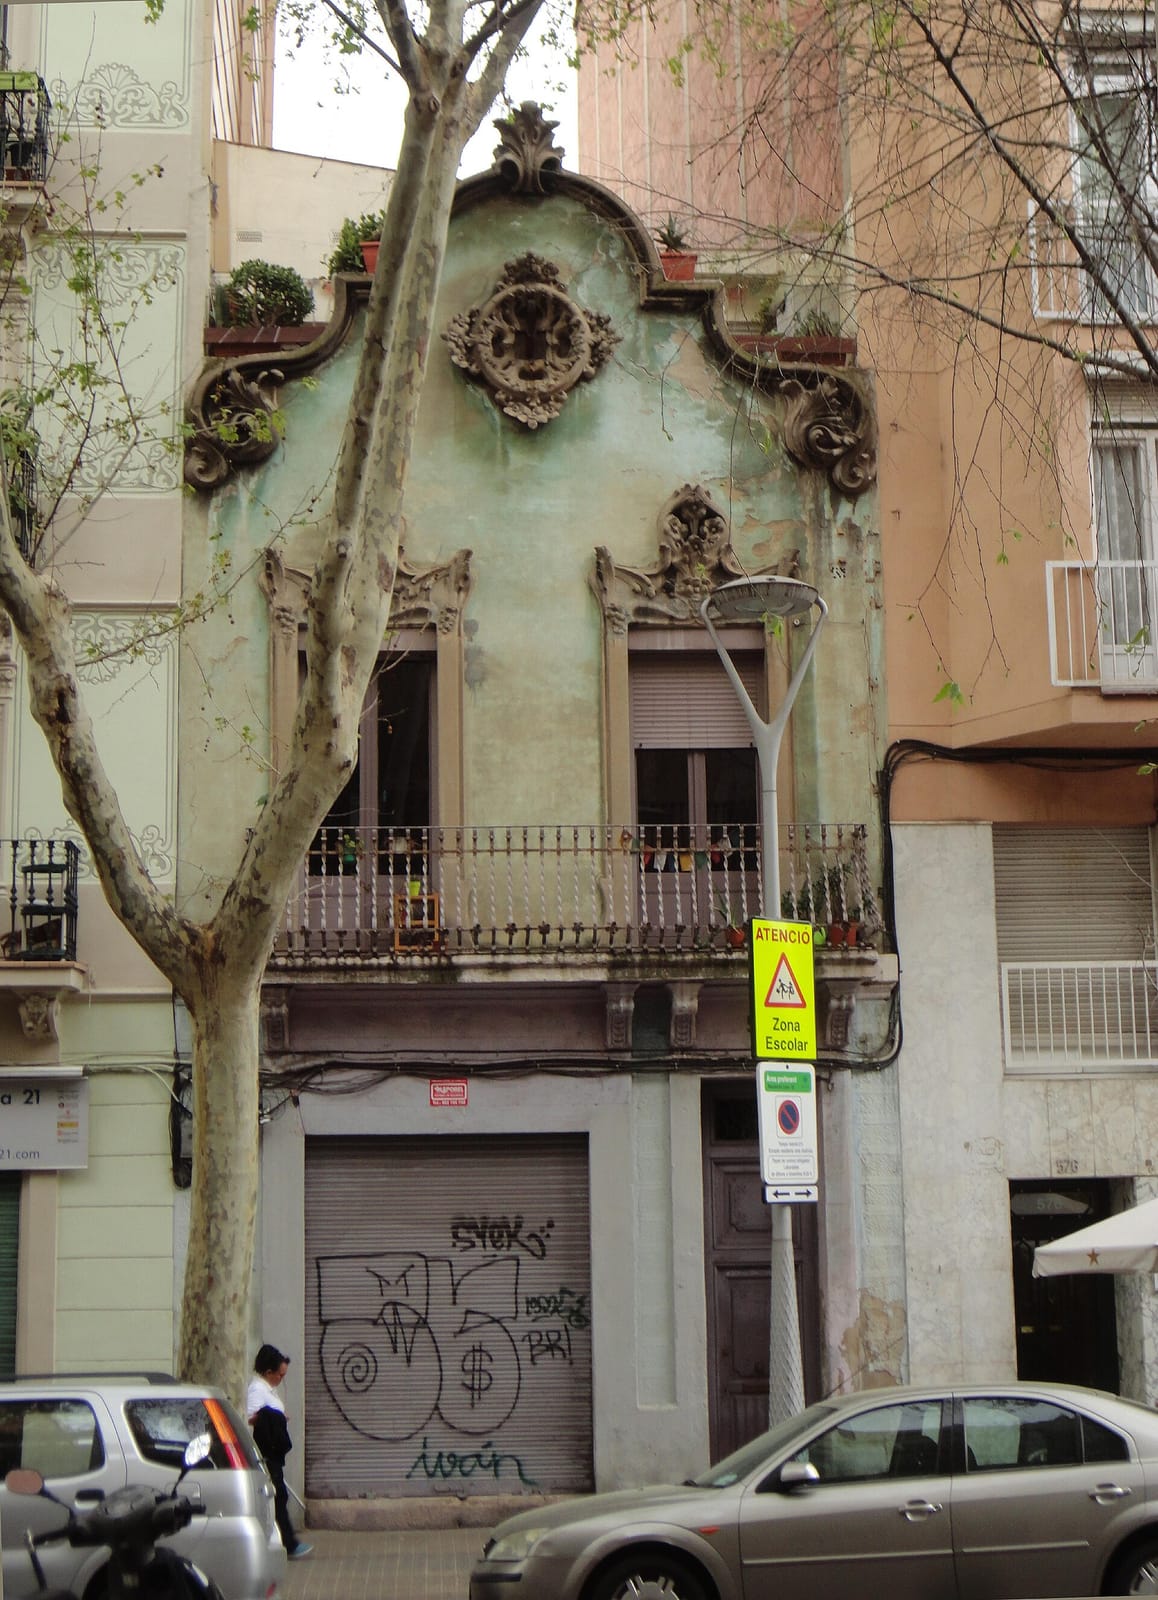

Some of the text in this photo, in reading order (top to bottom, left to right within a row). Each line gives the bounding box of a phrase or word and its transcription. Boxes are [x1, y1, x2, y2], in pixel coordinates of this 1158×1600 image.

[755, 926, 811, 945] ATENCIÓ
[772, 1017, 801, 1033] Zona
[765, 1036, 808, 1052] Escolar
[23, 1088, 40, 1105] 21
[1055, 1159, 1079, 1175] 576
